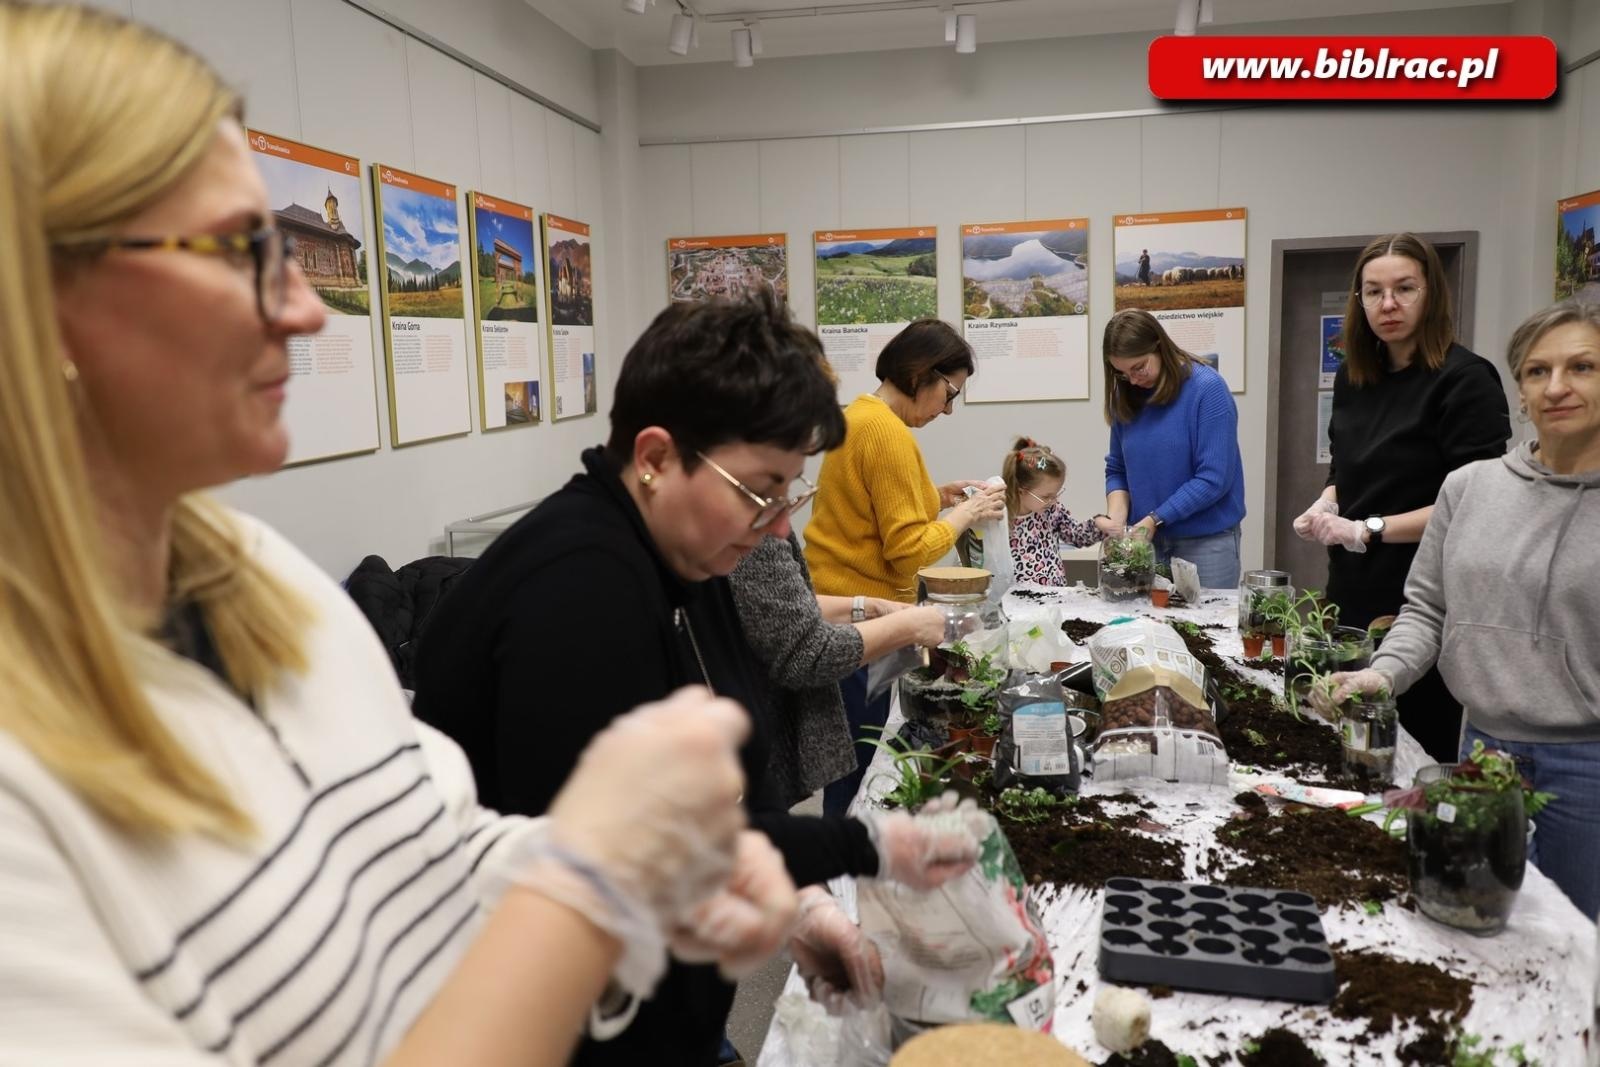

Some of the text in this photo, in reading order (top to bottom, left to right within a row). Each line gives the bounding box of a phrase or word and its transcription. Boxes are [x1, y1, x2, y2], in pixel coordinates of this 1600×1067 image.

[1157, 311, 1224, 320] dziedzictwo wiejskie
[392, 321, 407, 331] Kraina
[990, 321, 1018, 329] Rzymska
